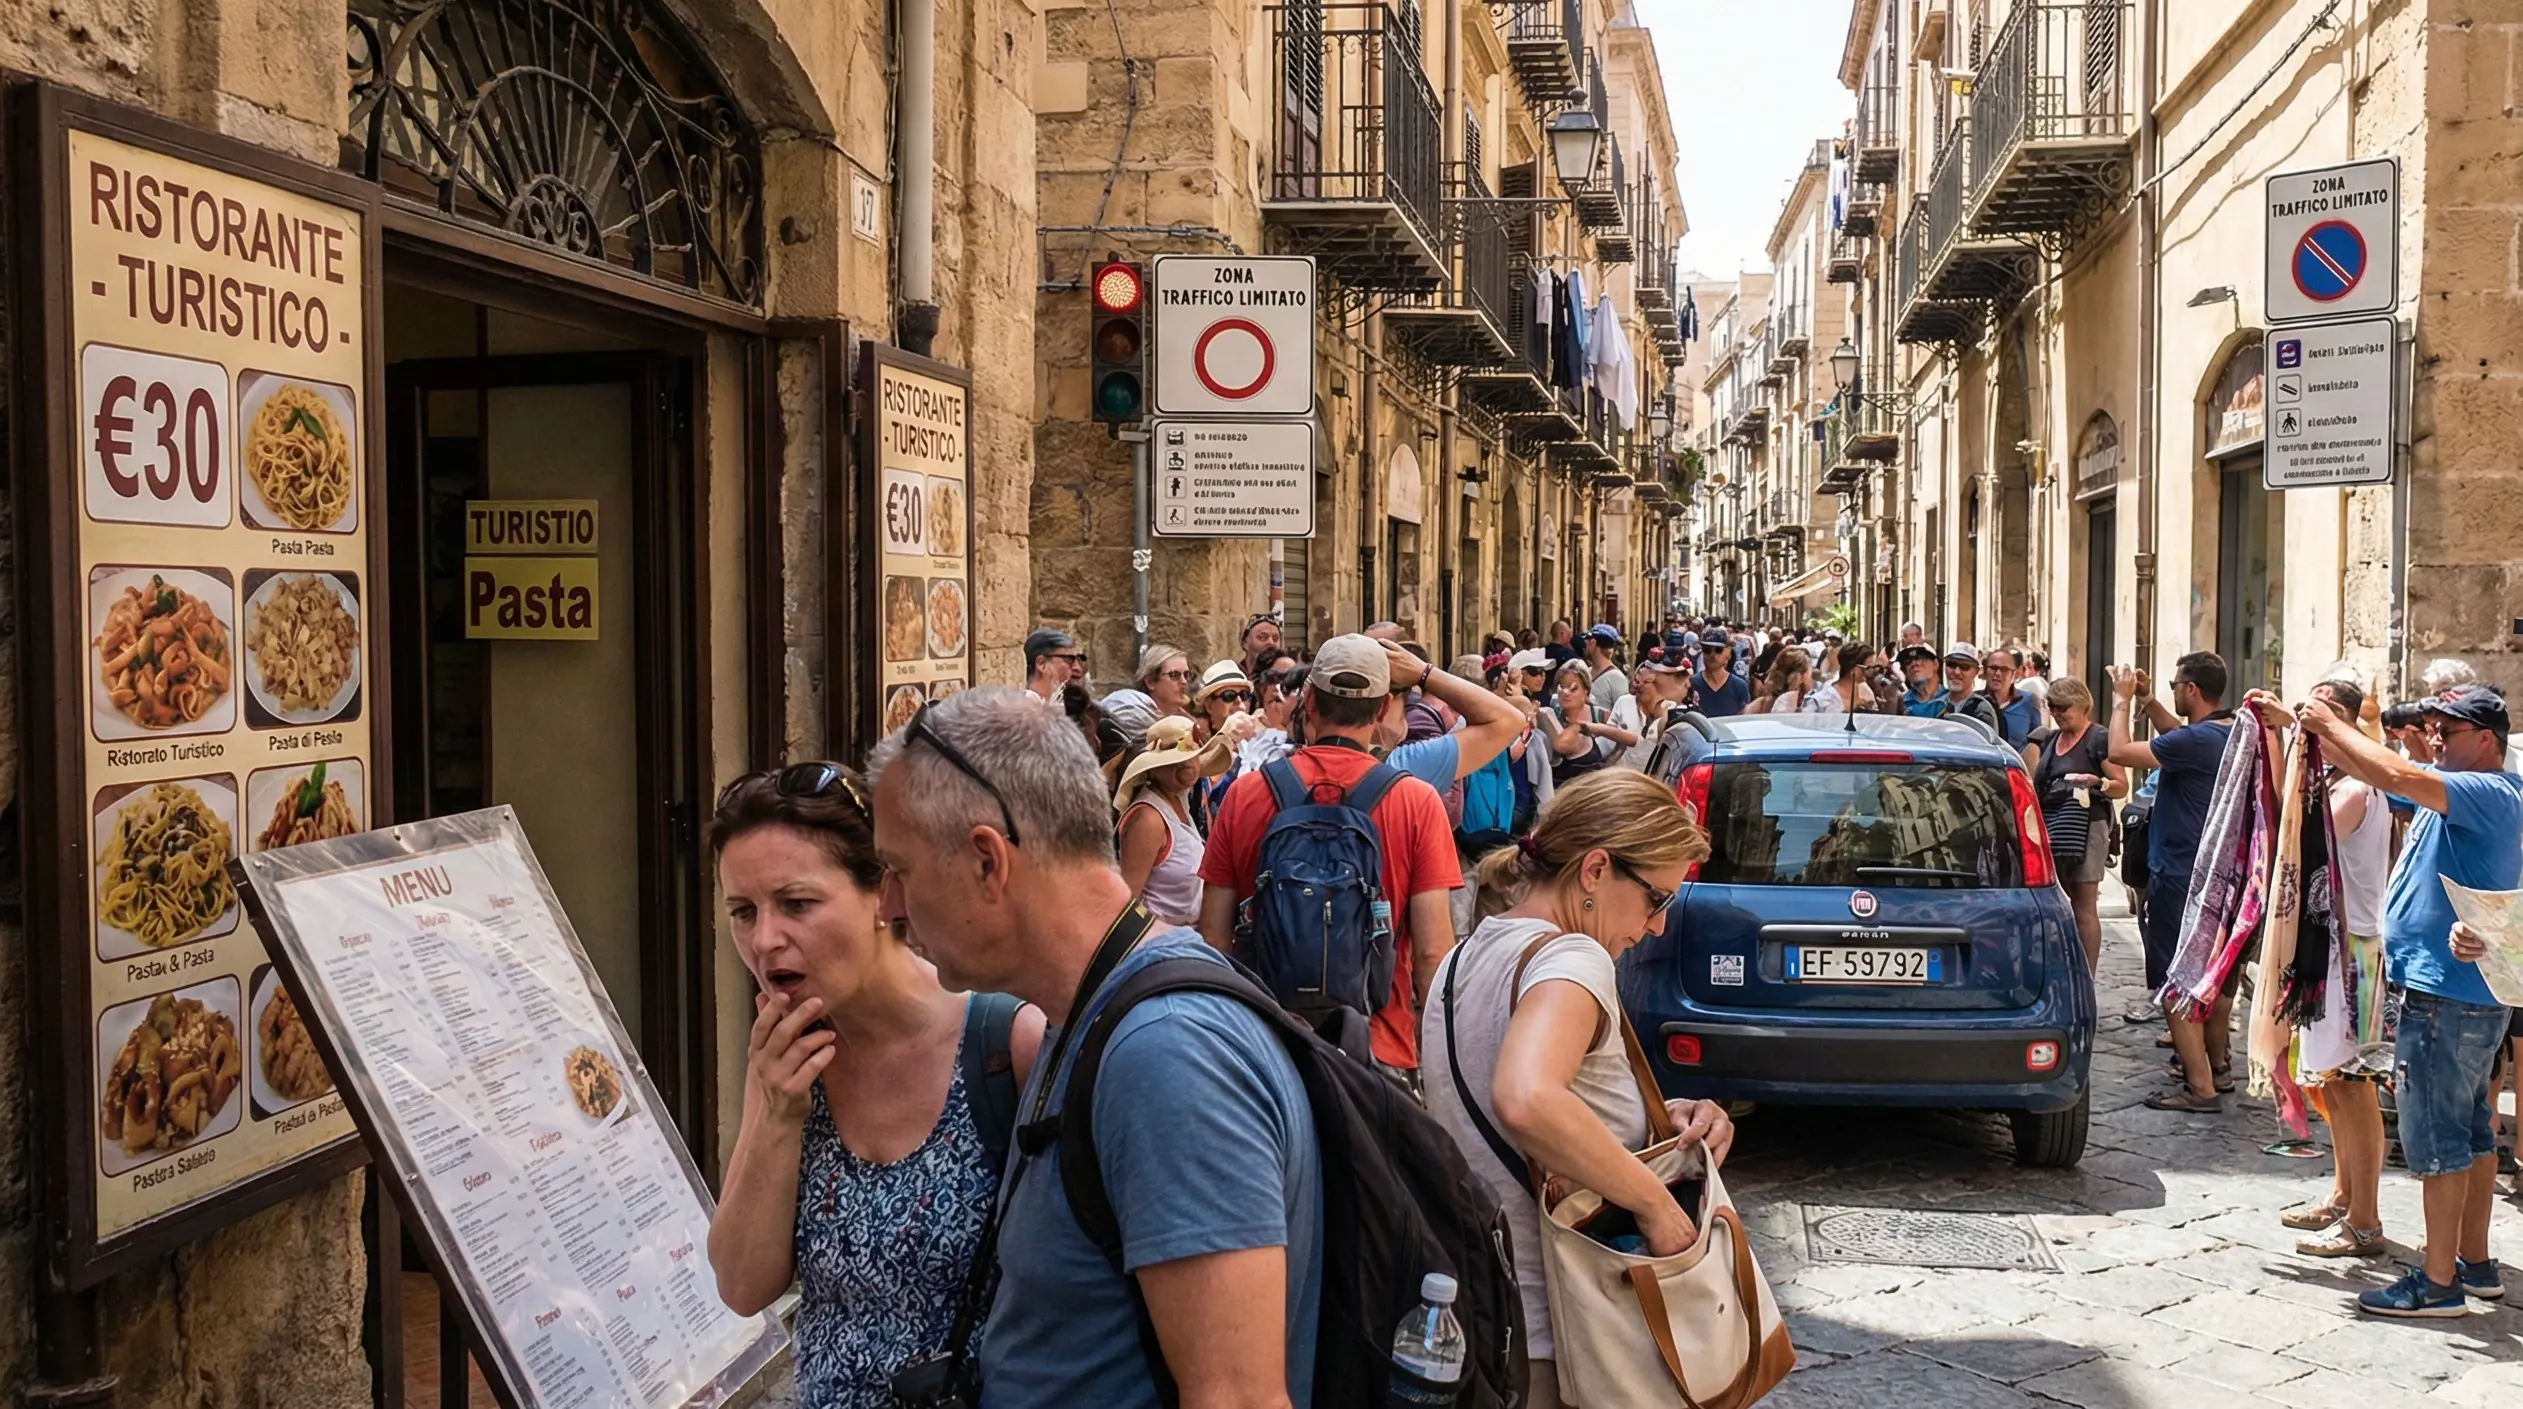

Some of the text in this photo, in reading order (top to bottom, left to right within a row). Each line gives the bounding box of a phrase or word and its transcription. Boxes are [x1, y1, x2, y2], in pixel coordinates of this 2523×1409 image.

[2272, 189, 2388, 218] TRAFFICO LIMITATO
[2312, 176, 2346, 194] ZONA
[90, 160, 344, 285] RISTORANTE
[1214, 267, 1254, 284] ZONA
[117, 253, 329, 354] TURISTICO
[1162, 289, 1306, 307] TRAFFICO LIMITATO
[884, 377, 962, 427] RISTORANTE
[94, 375, 220, 503] €30
[891, 421, 956, 464] TURISTICO
[470, 509, 594, 545] TURISTIO
[886, 482, 922, 545] €30
[470, 571, 592, 629] Pasta
[170, 741, 224, 761] Turistico
[379, 865, 453, 909] MENU
[183, 948, 214, 969] Pasta
[1803, 950, 1833, 976] EF
[1844, 951, 1924, 977] 59792
